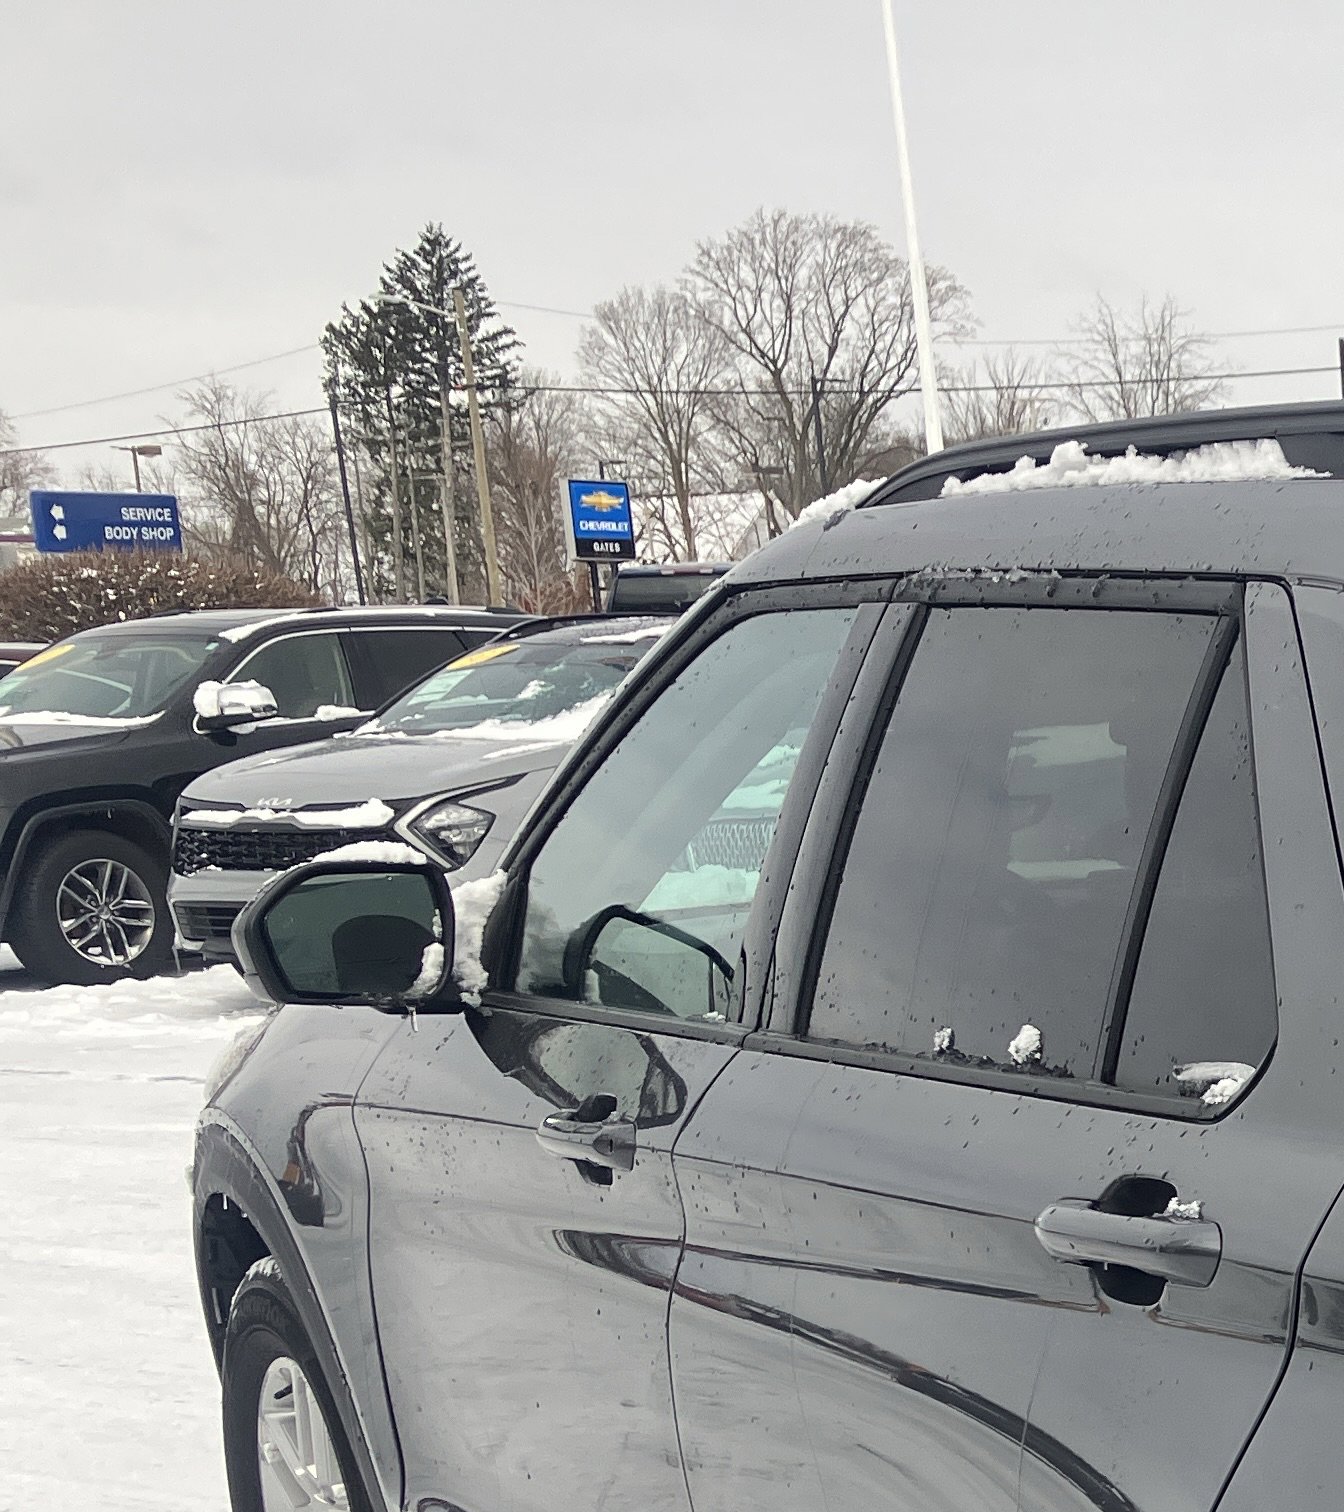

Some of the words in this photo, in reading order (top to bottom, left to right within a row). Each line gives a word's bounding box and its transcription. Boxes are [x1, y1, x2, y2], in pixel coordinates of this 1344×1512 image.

[120, 507, 173, 521] SERVICE
[580, 521, 628, 532] CHEVROLET
[104, 526, 138, 540] BODY
[141, 527, 174, 540] SHOP
[593, 542, 620, 553] GATES
